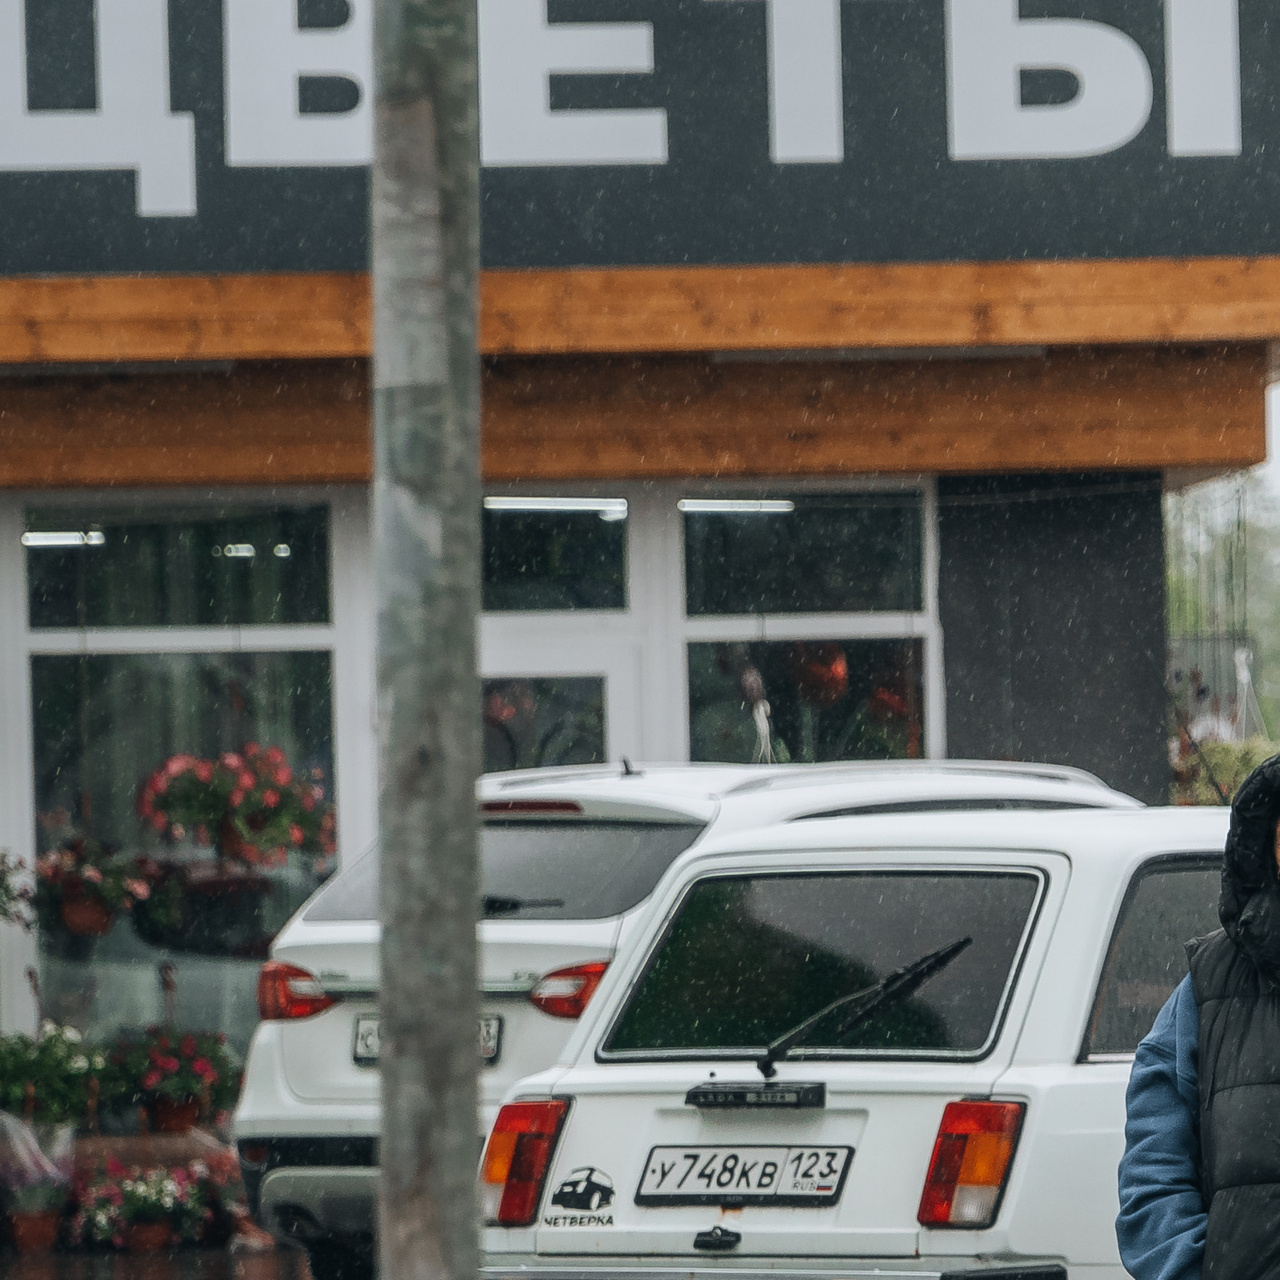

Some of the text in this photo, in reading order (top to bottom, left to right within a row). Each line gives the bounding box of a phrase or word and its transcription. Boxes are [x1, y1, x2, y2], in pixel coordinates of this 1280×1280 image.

[656, 1152, 838, 1189] У748КВ 123
[544, 1215, 614, 1227] ЧЕТВЕРКА
